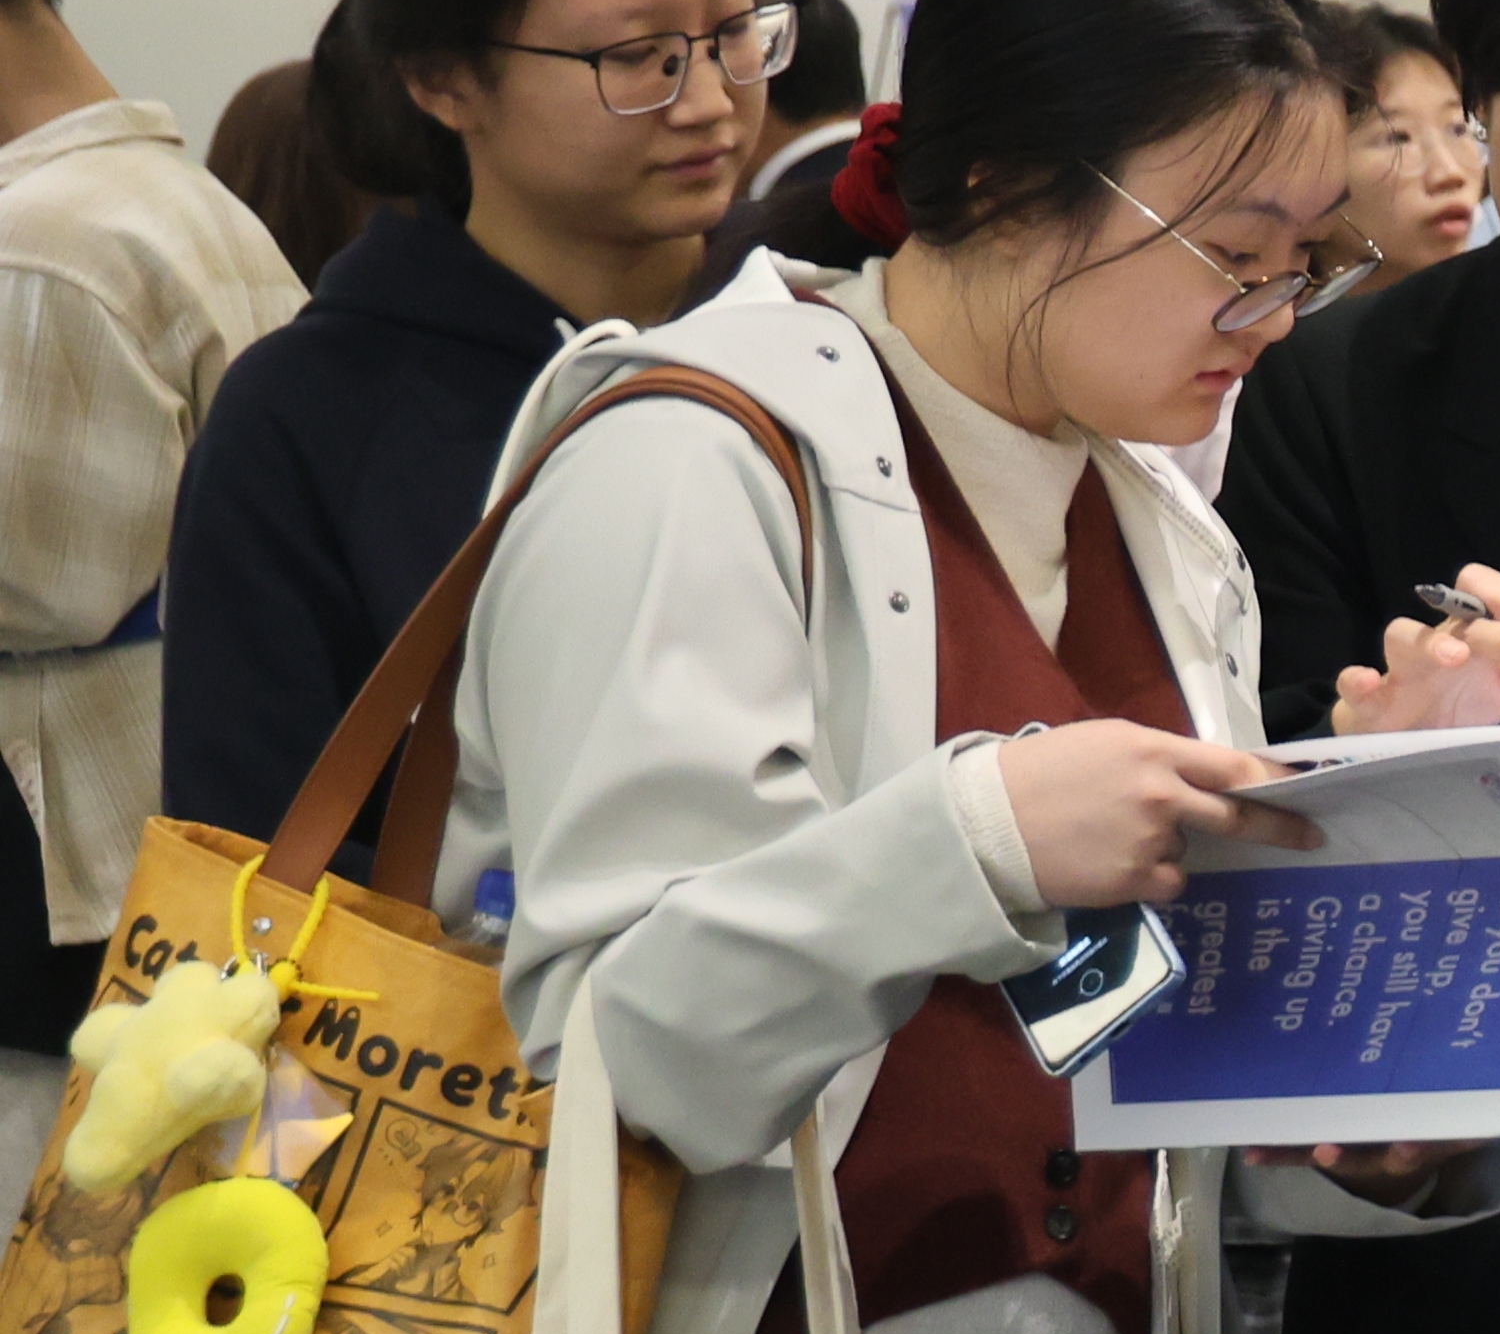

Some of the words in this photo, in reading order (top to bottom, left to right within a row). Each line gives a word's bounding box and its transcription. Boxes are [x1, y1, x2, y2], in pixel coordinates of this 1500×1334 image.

[1256, 897, 1292, 919] is
[1358, 892, 1380, 911] a
[1397, 889, 1432, 942] you
[1446, 888, 1486, 946] give
[1187, 898, 1229, 1017] greatest
[1246, 927, 1290, 974] the
[1282, 895, 1343, 990] Giving
[1325, 920, 1388, 1028] chance.
[1382, 951, 1419, 994] still
[1424, 951, 1461, 999] up,
[1274, 995, 1310, 1033] up
[1358, 998, 1412, 1065] have
